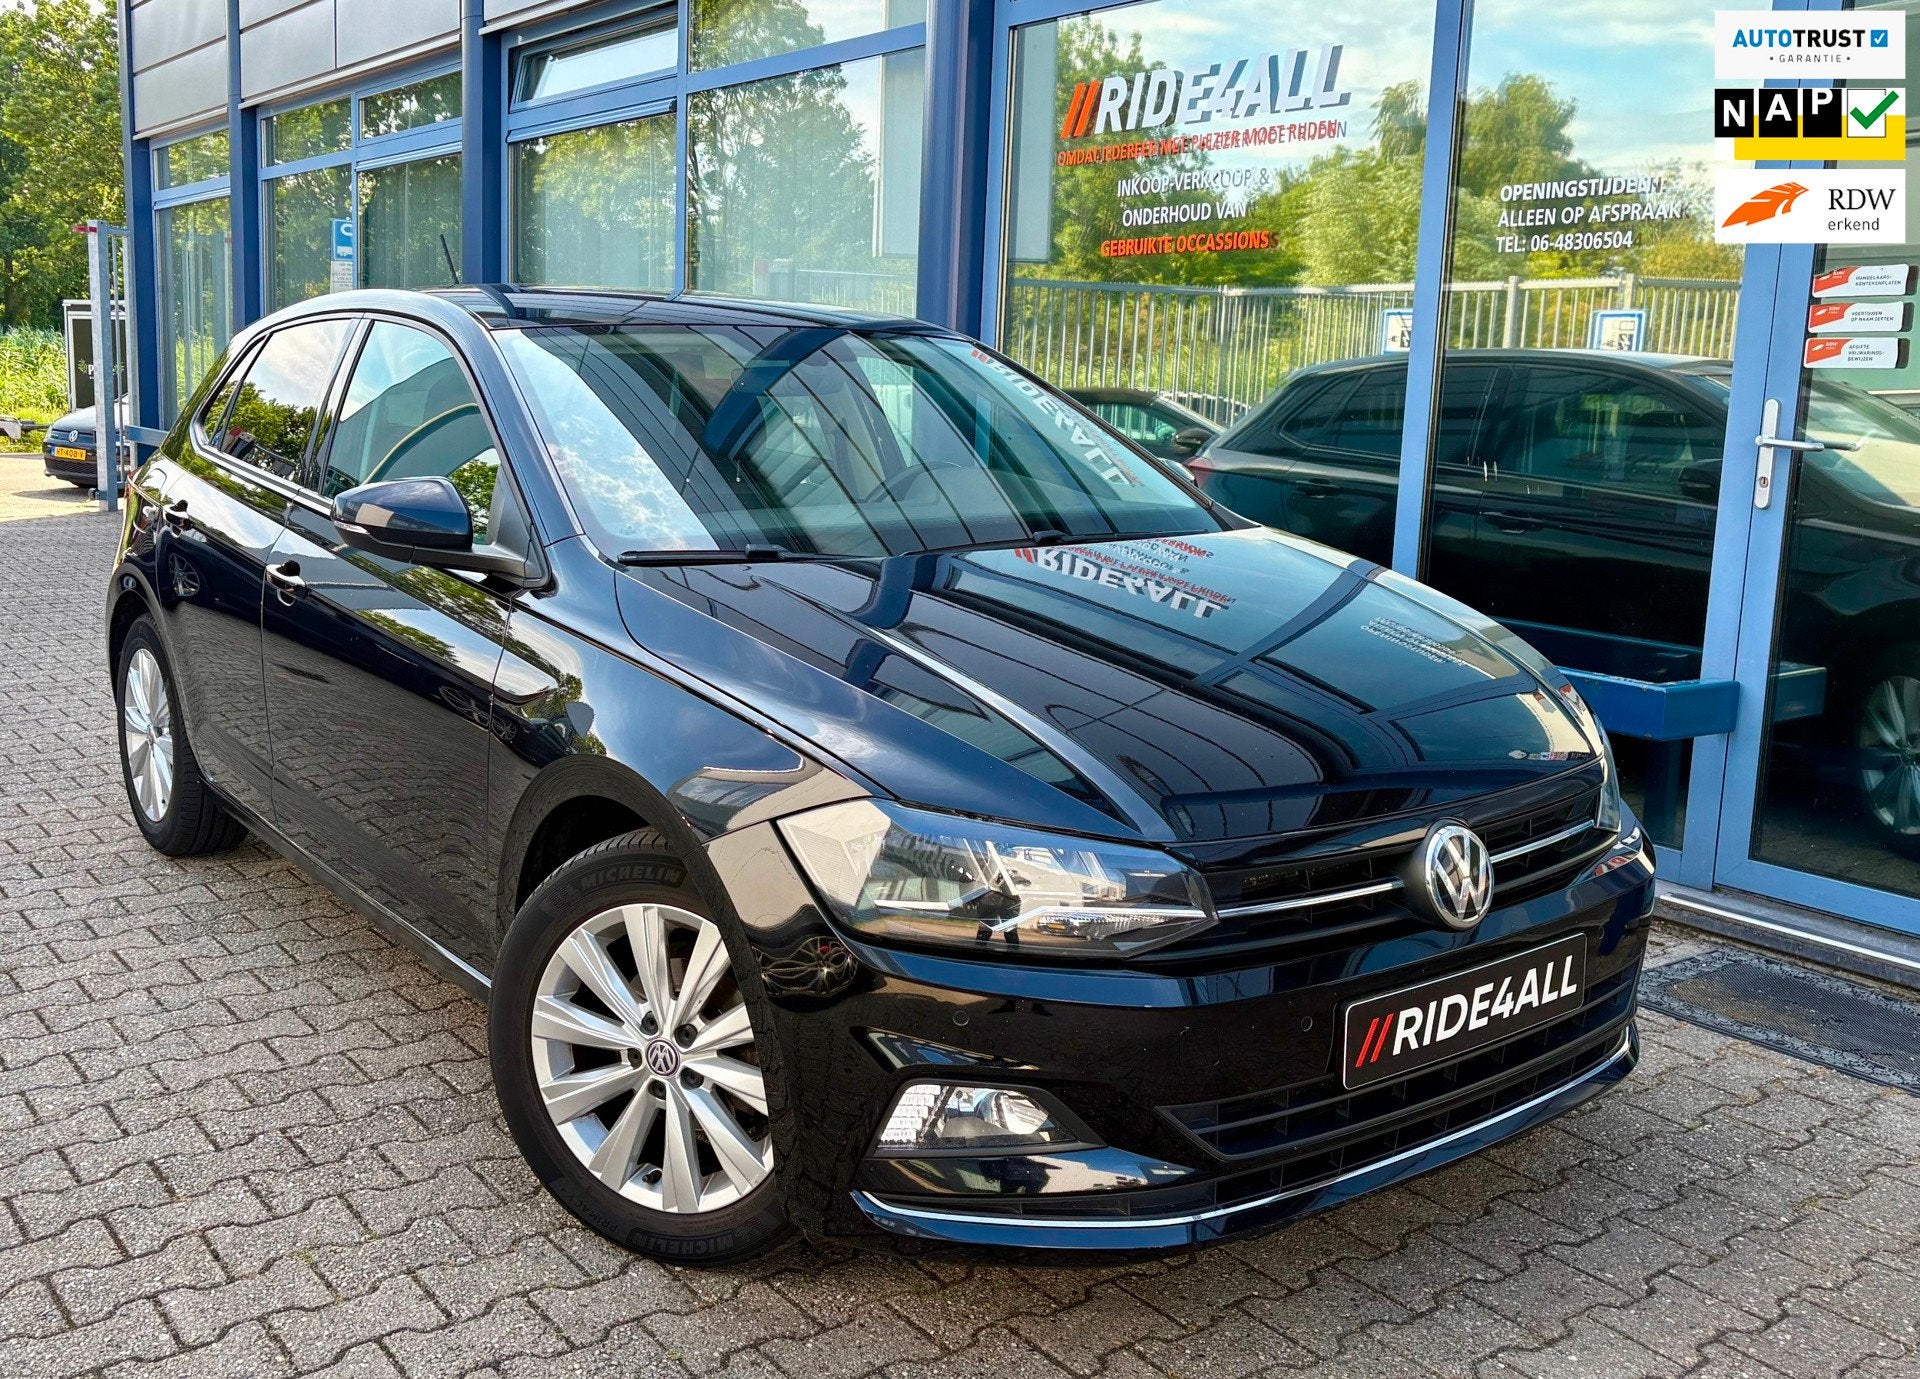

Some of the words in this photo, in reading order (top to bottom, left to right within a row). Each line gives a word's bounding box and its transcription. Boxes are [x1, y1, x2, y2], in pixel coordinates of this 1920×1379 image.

[1259, 167, 1270, 187] &
[1122, 202, 1212, 228] ONDERHOUD
[1216, 200, 1247, 219] VAN
[1497, 207, 1557, 228] ALLEEN
[1561, 206, 1585, 226] OP
[1588, 202, 1683, 223] AFSPRAAK
[1100, 234, 1173, 258] GEBRUIKTE
[1177, 230, 1271, 254] OCCASSIONS
[1496, 235, 1526, 253] TEL:
[1531, 231, 1633, 252] 06-48306504
[581, 865, 681, 889] MICHELIN
